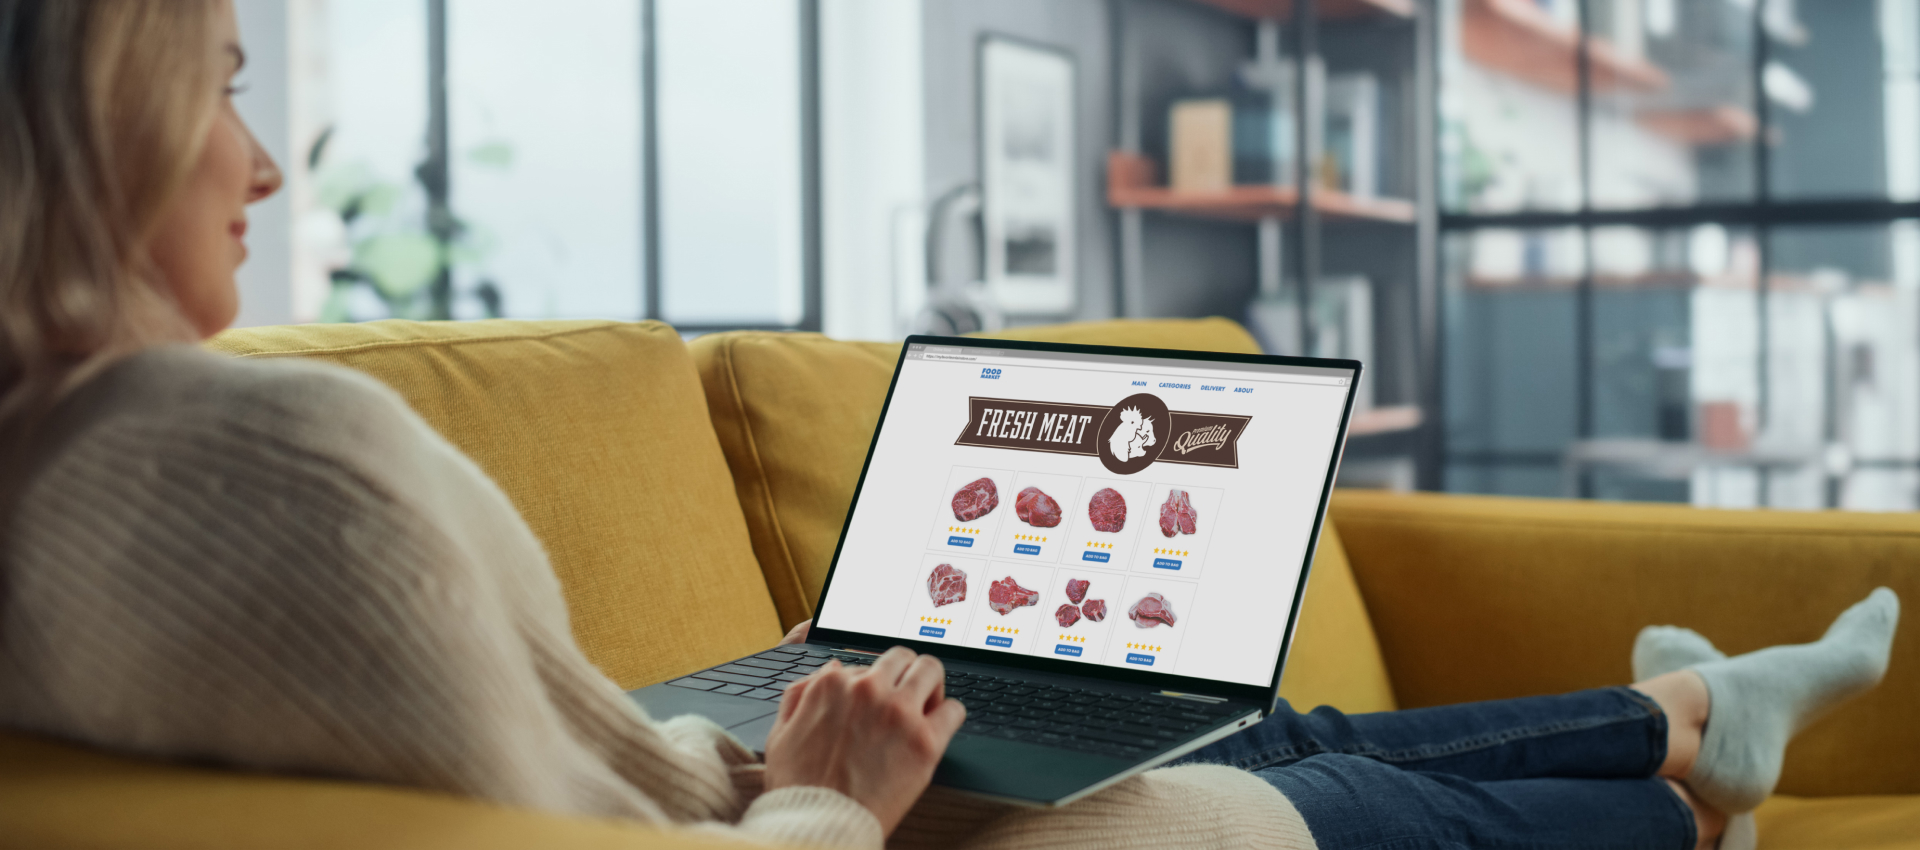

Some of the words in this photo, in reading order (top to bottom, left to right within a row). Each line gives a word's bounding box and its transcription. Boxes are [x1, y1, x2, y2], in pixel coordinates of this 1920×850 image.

[976, 408, 1038, 440] FRESH
[1036, 412, 1092, 444] MEAT
[1174, 424, 1232, 454] Quality
